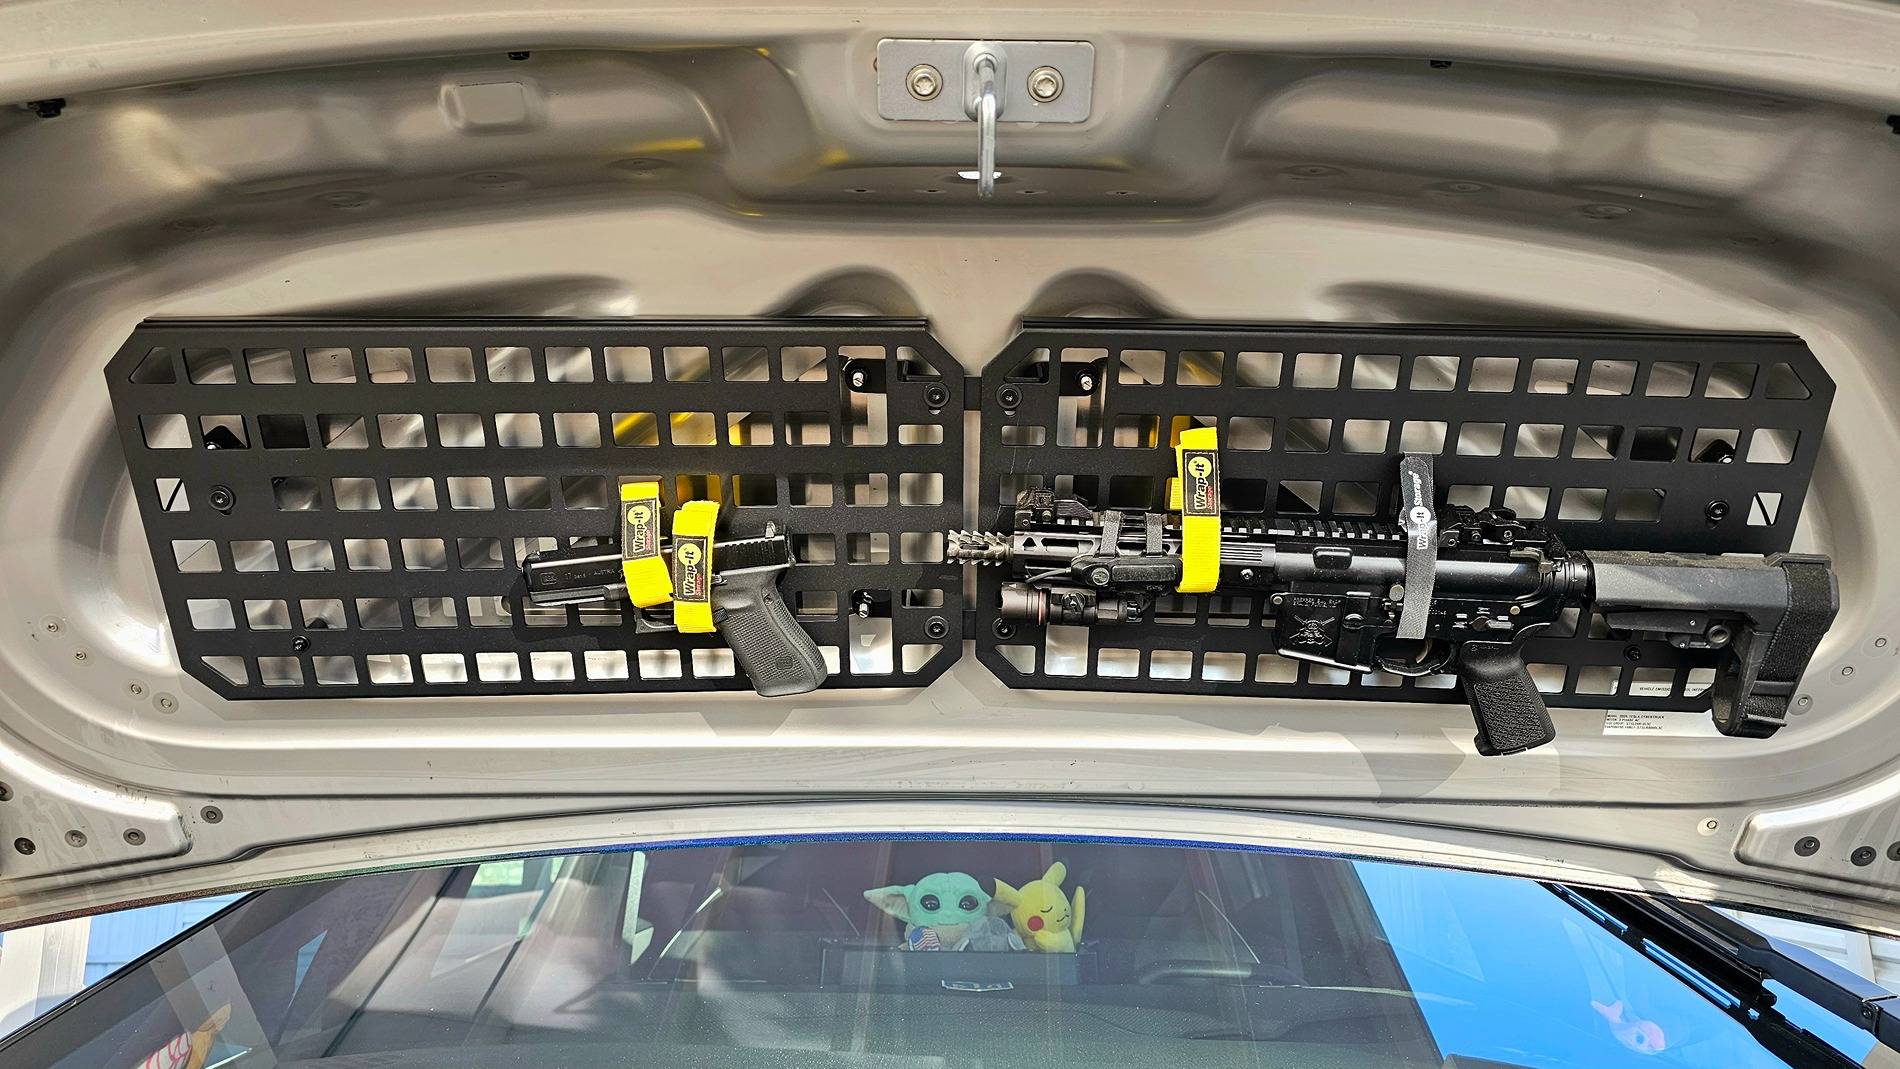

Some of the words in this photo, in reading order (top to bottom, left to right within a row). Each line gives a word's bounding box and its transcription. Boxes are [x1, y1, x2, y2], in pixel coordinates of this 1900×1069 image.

[1194, 463, 1208, 510] Wrap-It
[1412, 474, 1423, 506] Storage
[633, 511, 646, 552] Wrap-It
[684, 551, 697, 595] Wrap-It
